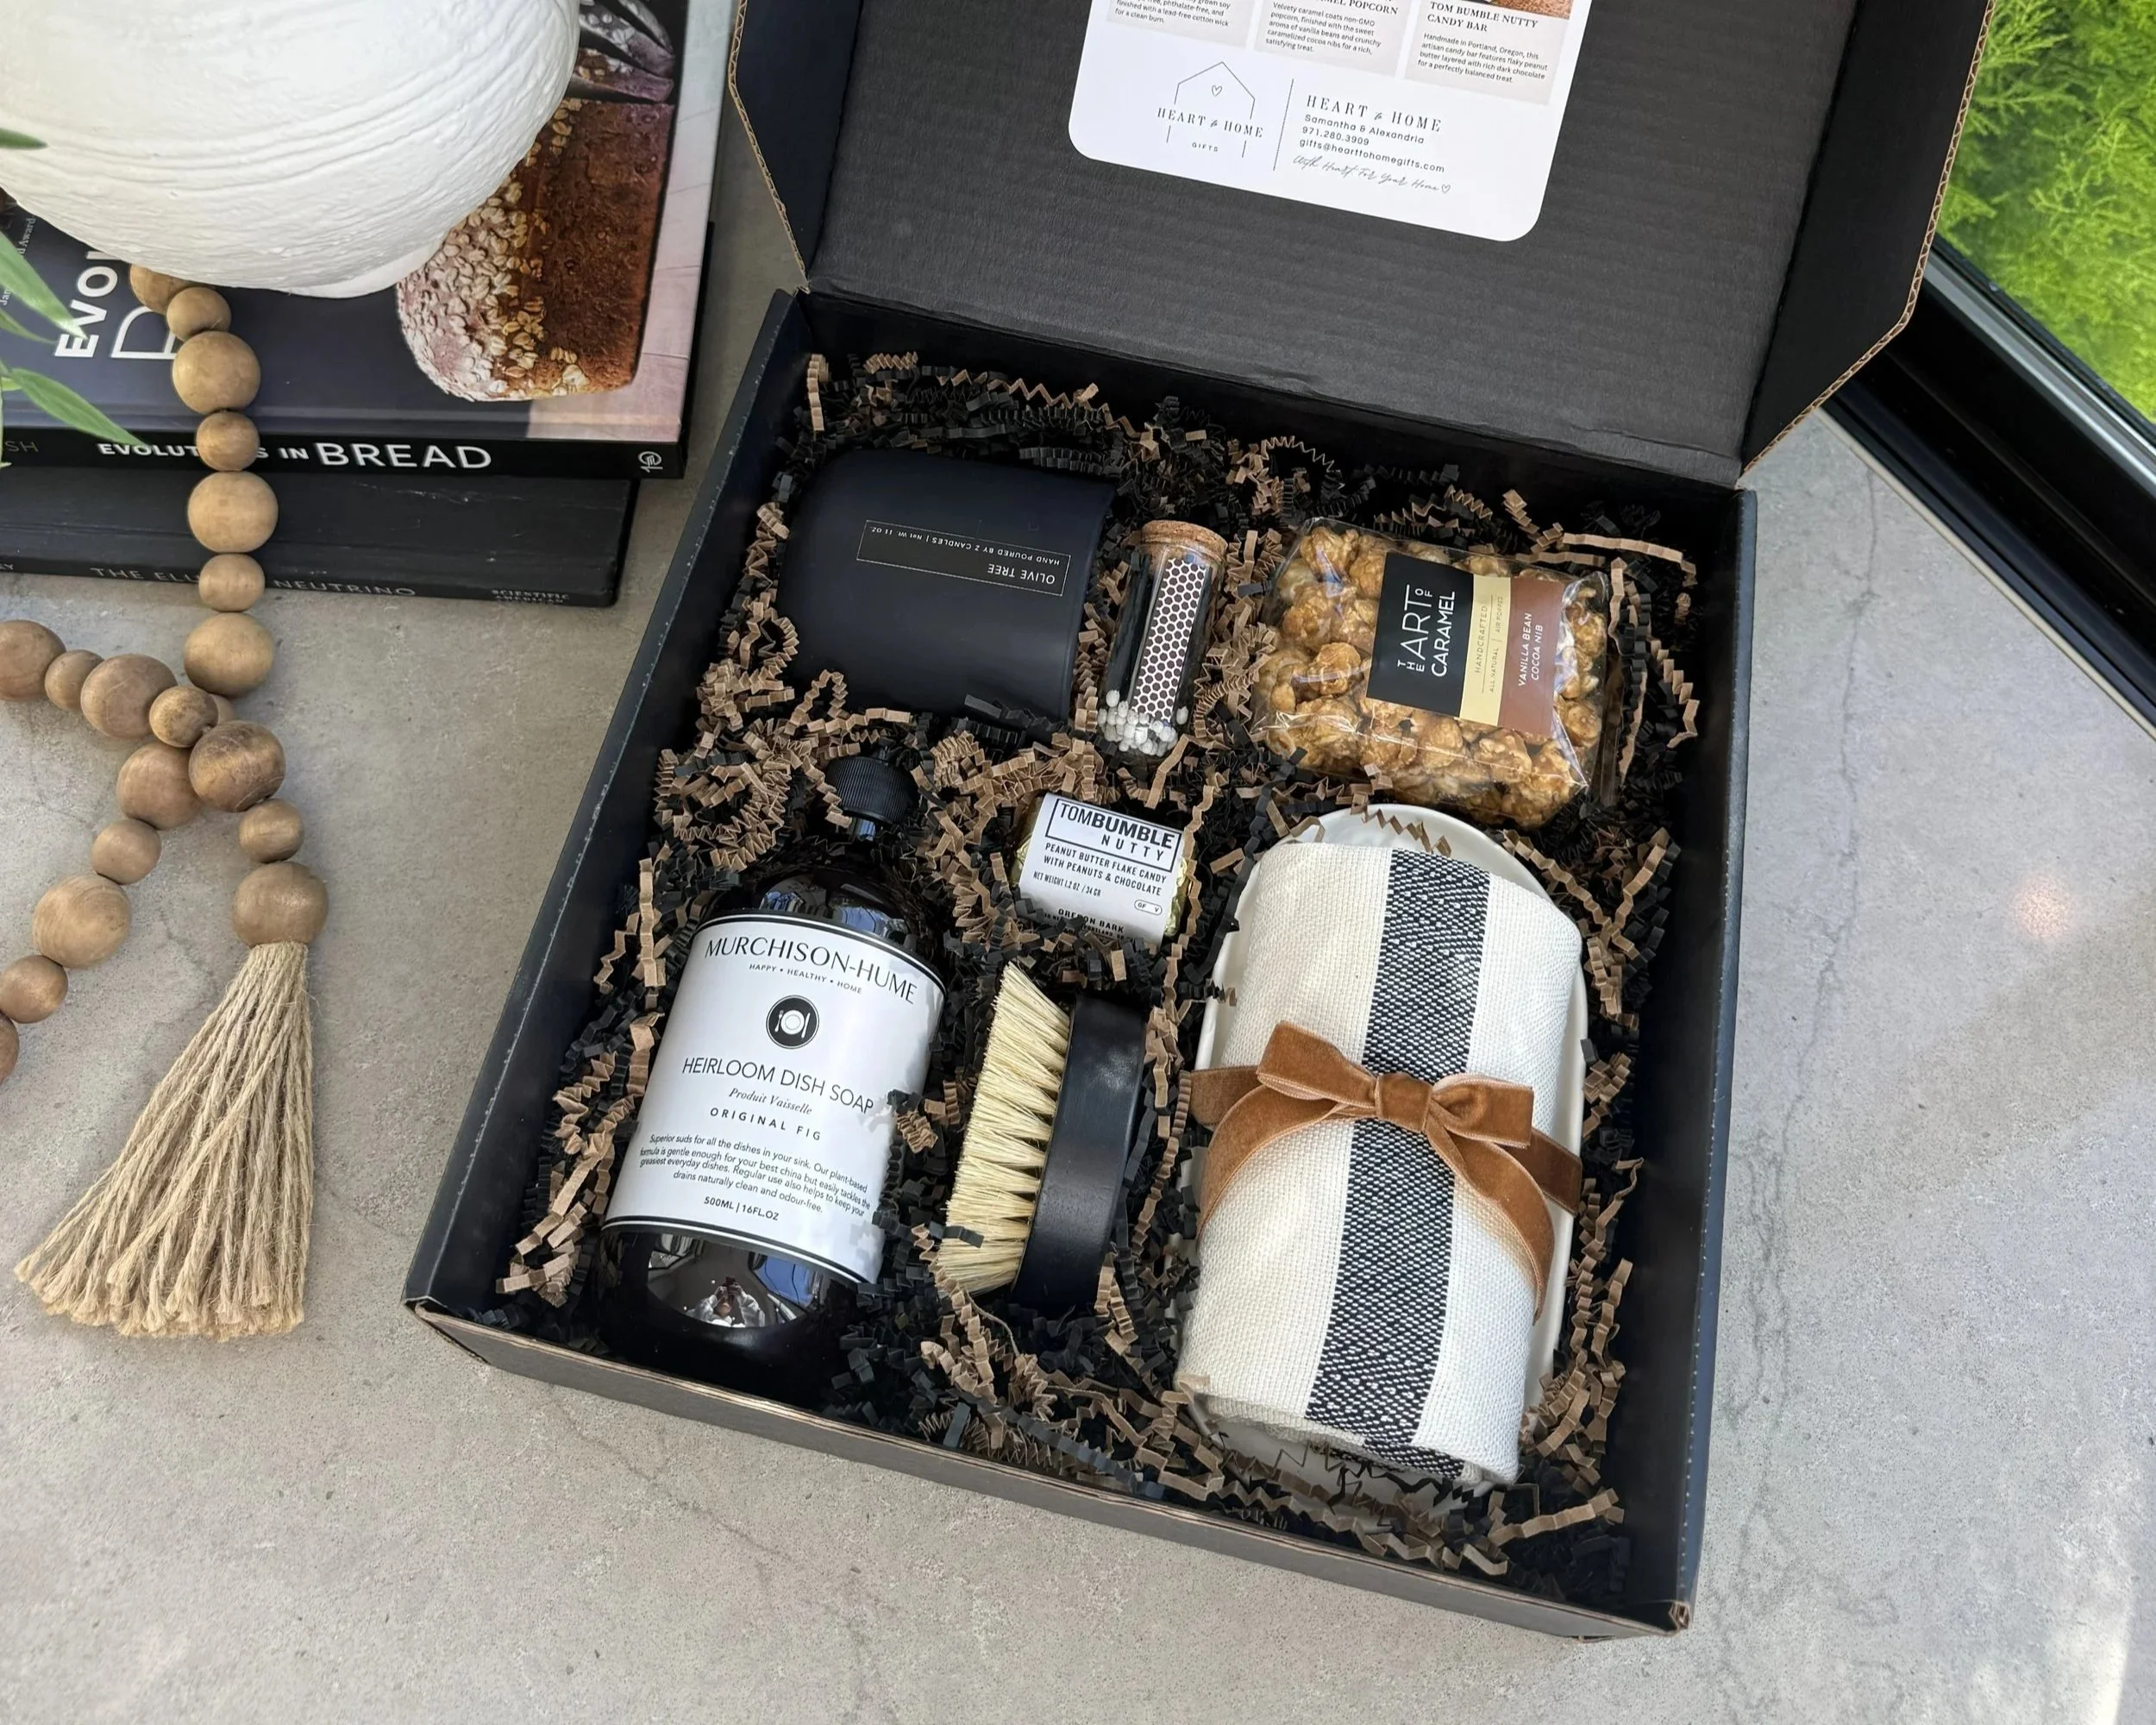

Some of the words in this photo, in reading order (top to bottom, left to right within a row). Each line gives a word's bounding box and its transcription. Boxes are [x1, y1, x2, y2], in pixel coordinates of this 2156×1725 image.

[1163, 9, 1191, 19] lead-free
[1193, 15, 1213, 24] cotton
[1273, 3, 1297, 13] Velvety
[1299, 8, 1324, 16] caramel
[1326, 12, 1342, 21] coats
[1344, 16, 1376, 27] non-GMO
[1350, 0, 1399, 15] POPCORN
[1430, 2, 1454, 12] TOM
[1457, 6, 1500, 22] BUMBLE
[1502, 15, 1539, 28] NUTTY
[1269, 21, 1289, 29] aroma
[1299, 25, 1319, 35] vanilla
[1321, 29, 1340, 39] beans
[1355, 36, 1382, 47] crunchy
[1300, 16, 1326, 27] finished
[1356, 28, 1374, 36] sweet
[1427, 14, 1464, 28] CANDY
[1467, 22, 1488, 32] BAR
[1266, 38, 1296, 50] satisfying
[1267, 29, 1306, 41] caramelized
[1307, 36, 1326, 45] cocoa
[1327, 40, 1340, 48] nibs
[1423, 33, 1459, 45] Handmade
[1468, 41, 1498, 53] Portland,
[1499, 47, 1525, 59] Oregon,
[1420, 52, 1440, 60] butter
[1441, 55, 1466, 66] layered
[1497, 65, 1511, 73] dark
[1513, 67, 1545, 79] chocolate
[1422, 42, 1444, 53] artisan
[1445, 46, 1465, 57] candy
[1479, 52, 1506, 63] features
[1507, 57, 1523, 66] flaky
[1524, 61, 1548, 71] peanut
[1433, 63, 1463, 74] perfectly
[1465, 68, 1495, 79] balanced
[1157, 107, 1206, 126] HEART
[1225, 121, 1263, 138] HOME
[1307, 95, 1368, 117] HEART
[1391, 111, 1442, 132] HOME
[1302, 126, 1369, 146] 971.280.3909
[1305, 114, 1357, 131] Samantha
[1369, 127, 1425, 144] Alexandria
[1192, 141, 1219, 152] GIFTS
[1300, 138, 1445, 172] gifts@hearttohomegifts.com
[279, 447, 310, 460] IN
[313, 442, 492, 469] BREAD
[931, 536, 972, 550] CANDLES
[997, 549, 1033, 561] POURED
[987, 563, 1015, 578] TREE
[1036, 555, 1060, 566] HAND
[90, 567, 144, 580] THE
[273, 579, 416, 596] NEUTRINO
[1020, 569, 1056, 585] OLIVE
[1401, 584, 1432, 661] ART
[1431, 591, 1456, 677] CARAMEL
[1522, 613, 1532, 640] BEAN
[1475, 605, 1488, 674] HANDCRAFTED
[1397, 659, 1426, 673] THE
[1490, 648, 1499, 677] NATURAL
[1518, 643, 1529, 687] VANILLA
[1532, 646, 1540, 681] COCOA
[1060, 803, 1175, 850] TOMBUMBLE
[1101, 834, 1165, 862] NUTTY
[1044, 856, 1064, 868] WITH
[1066, 862, 1103, 880] PEANUTS
[1105, 873, 1112, 881] &
[1114, 875, 1162, 896] CHOCOLATE
[1045, 843, 1077, 858] PEANUT
[1079, 851, 1110, 868] BUTTER
[1112, 861, 1138, 875] FLAKE
[1139, 869, 1167, 884] CANDY
[1033, 871, 1044, 881] NET
[1044, 873, 1064, 886] WEIGHT
[1073, 882, 1080, 891] OZ
[1100, 919, 1124, 933] BARK
[705, 936, 918, 1005] MURCHISON-HUME
[749, 963, 777, 973] HAPPY
[787, 969, 827, 982] HEALTHY
[837, 981, 862, 994] HOME
[682, 1057, 776, 1082] HEIRLOOM
[780, 1069, 825, 1096] DISH
[830, 1083, 874, 1114] SOAP
[729, 1087, 767, 1104] Produit
[769, 1095, 812, 1115] Vaisselle
[710, 1107, 786, 1132] ORIGINAL
[797, 1125, 821, 1140] FIG
[650, 1133, 675, 1145] Superior
[676, 1135, 692, 1144] suds
[694, 1134, 705, 1145] for
[707, 1137, 717, 1145] all
[718, 1138, 731, 1149] the
[733, 1142, 761, 1155] dishes
[763, 1147, 770, 1157] in
[772, 1152, 792, 1163] your
[793, 1157, 811, 1170] sink.
[814, 1163, 829, 1175] Our
[830, 1170, 868, 1193] plant-based
[640, 1147, 660, 1156] formula
[667, 1147, 690, 1157] gentle
[692, 1151, 722, 1162] enough
[724, 1152, 736, 1163] for
[738, 1157, 757, 1167] your
[760, 1160, 778, 1173] best
[780, 1167, 802, 1180] china
[804, 1173, 818, 1186] but
[819, 1180, 839, 1195] easily
[841, 1189, 862, 1204] tackles
[862, 1198, 871, 1210] the
[640, 1157, 666, 1168] greasiest
[667, 1157, 700, 1170] everyday
[702, 1160, 730, 1173] dishes.
[733, 1164, 766, 1180] Regular
[768, 1176, 783, 1185] use
[785, 1179, 801, 1191] also
[803, 1184, 824, 1200] helps
[835, 1195, 851, 1212] keep
[851, 1207, 865, 1217] your
[674, 1170, 696, 1181] drains
[698, 1174, 733, 1189] naturally
[735, 1180, 758, 1193] clean
[761, 1186, 778, 1198] and
[779, 1192, 823, 1213] odour-free.
[704, 1196, 735, 1209] 500ML
